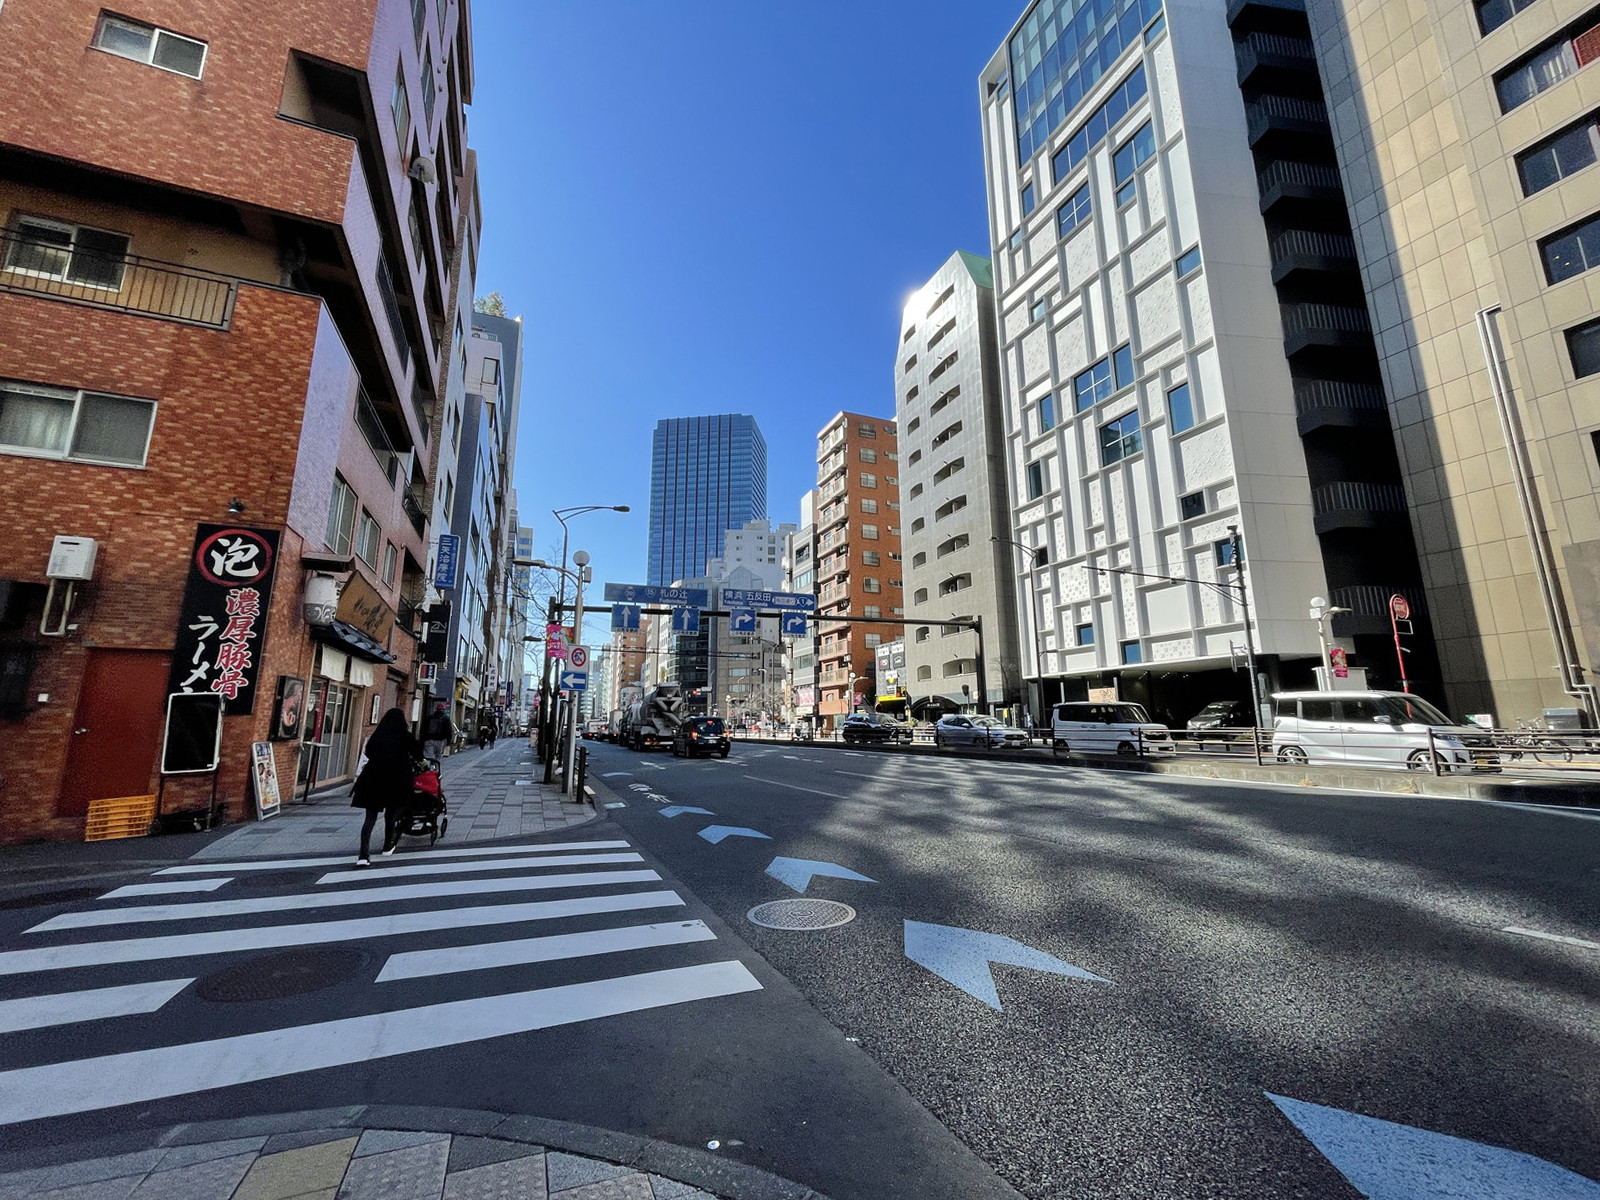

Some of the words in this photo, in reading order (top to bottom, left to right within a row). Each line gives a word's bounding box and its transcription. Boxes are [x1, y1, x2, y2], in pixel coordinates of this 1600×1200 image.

[211, 537, 260, 577] 泡
[660, 589, 688, 599] 札の辻
[725, 590, 743, 600] 横浜
[746, 591, 771, 601] 五反田
[211, 588, 260, 699] 濃厚豚骨
